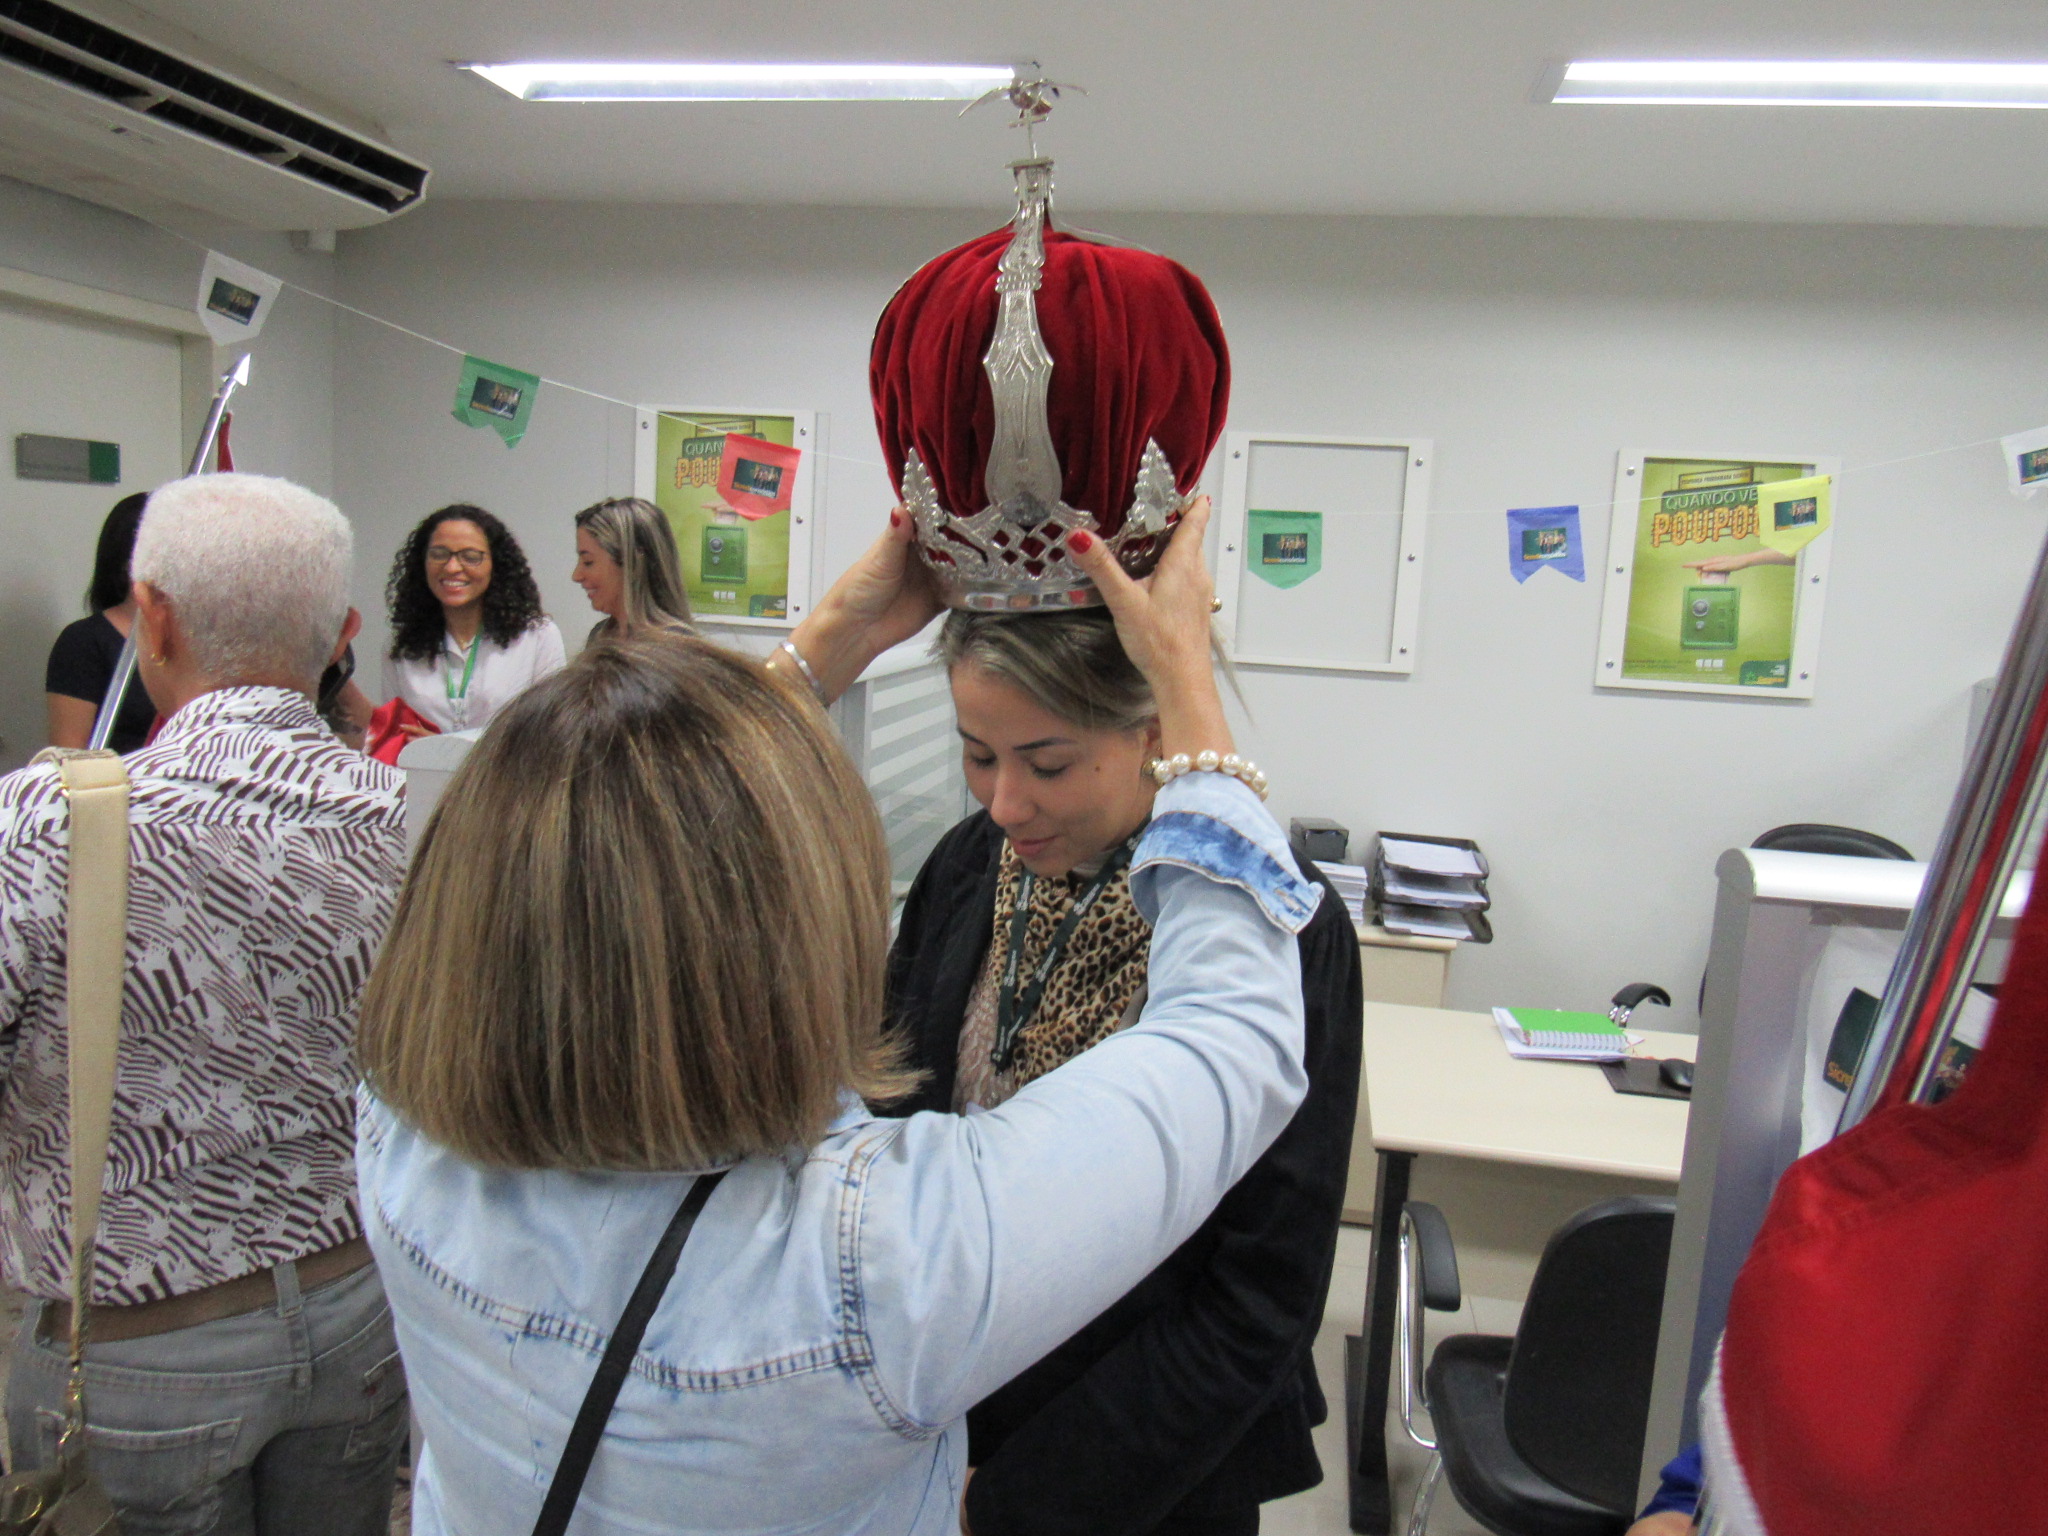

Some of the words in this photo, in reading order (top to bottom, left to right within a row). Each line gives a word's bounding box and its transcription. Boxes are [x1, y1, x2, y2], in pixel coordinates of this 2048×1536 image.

[685, 441, 723, 456] QUAN
[675, 456, 721, 490] POU
[1666, 491, 1736, 509] QUANDO
